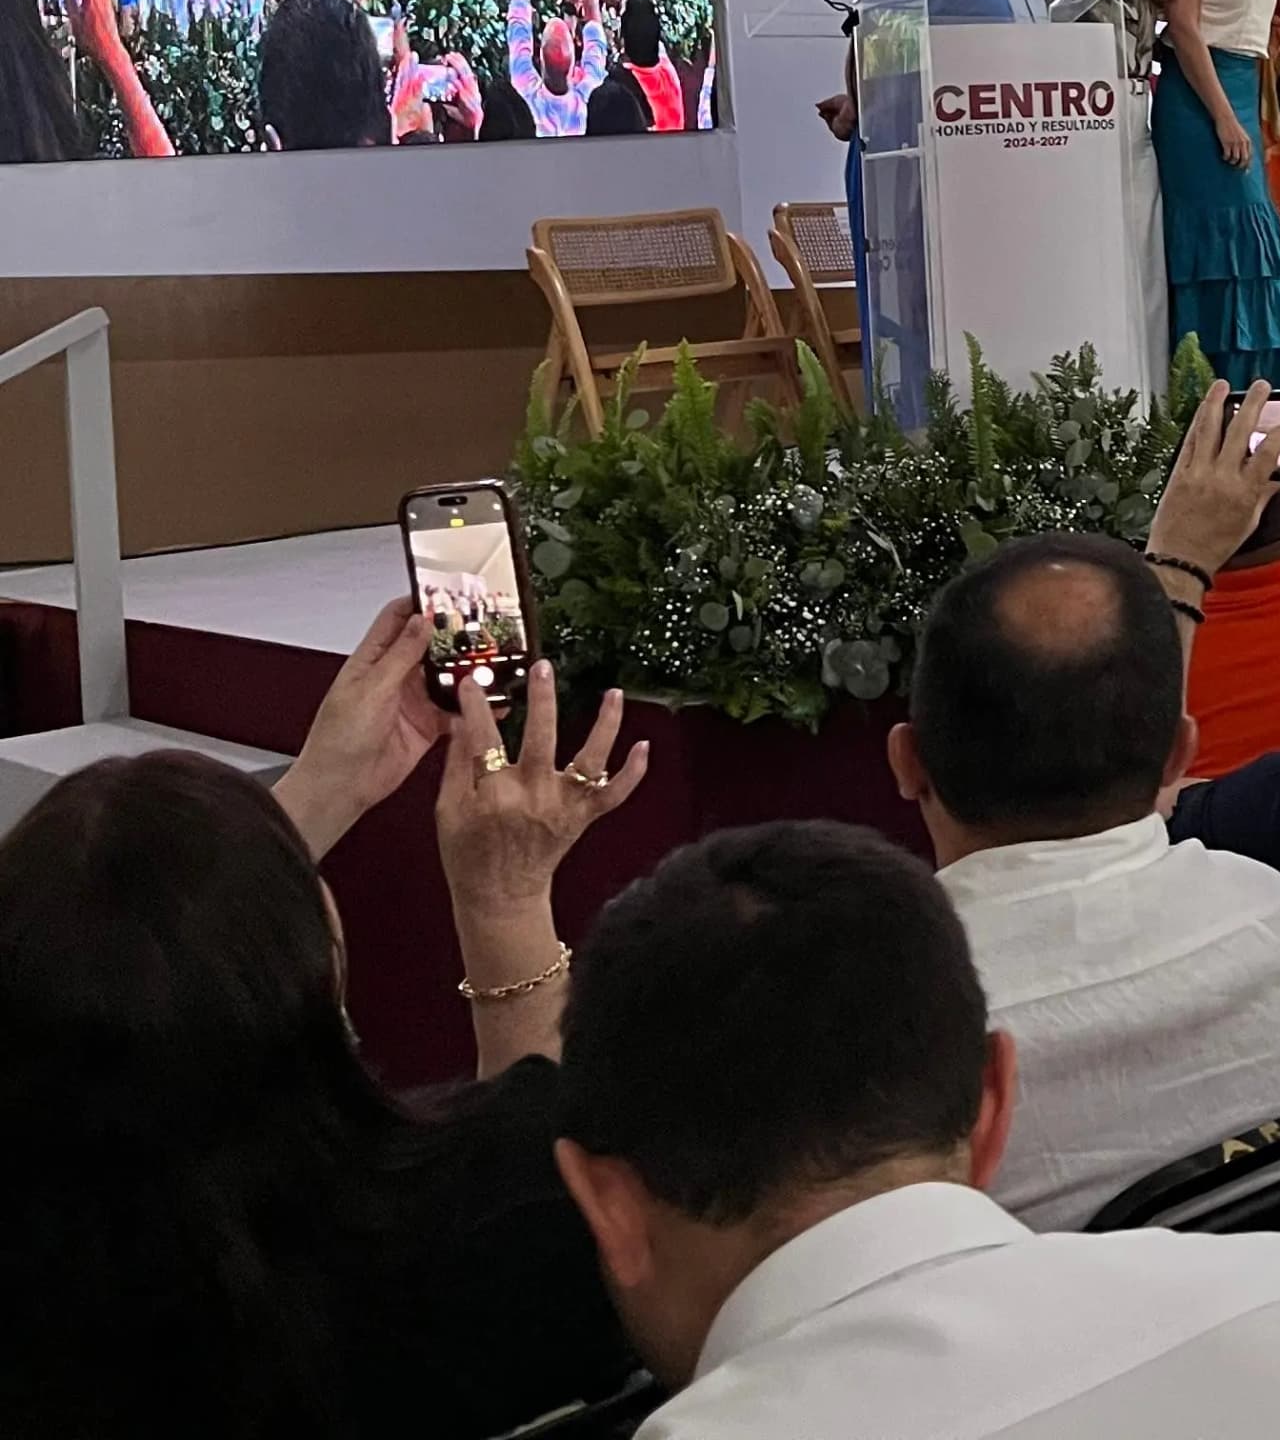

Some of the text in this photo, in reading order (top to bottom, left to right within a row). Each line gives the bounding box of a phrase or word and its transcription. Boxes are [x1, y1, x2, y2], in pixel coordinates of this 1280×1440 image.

[933, 80, 1115, 123] CENTRO
[931, 118, 1115, 137] HONESTIDAD Y RESULTADOS
[1003, 135, 1069, 149] 2024-2027
